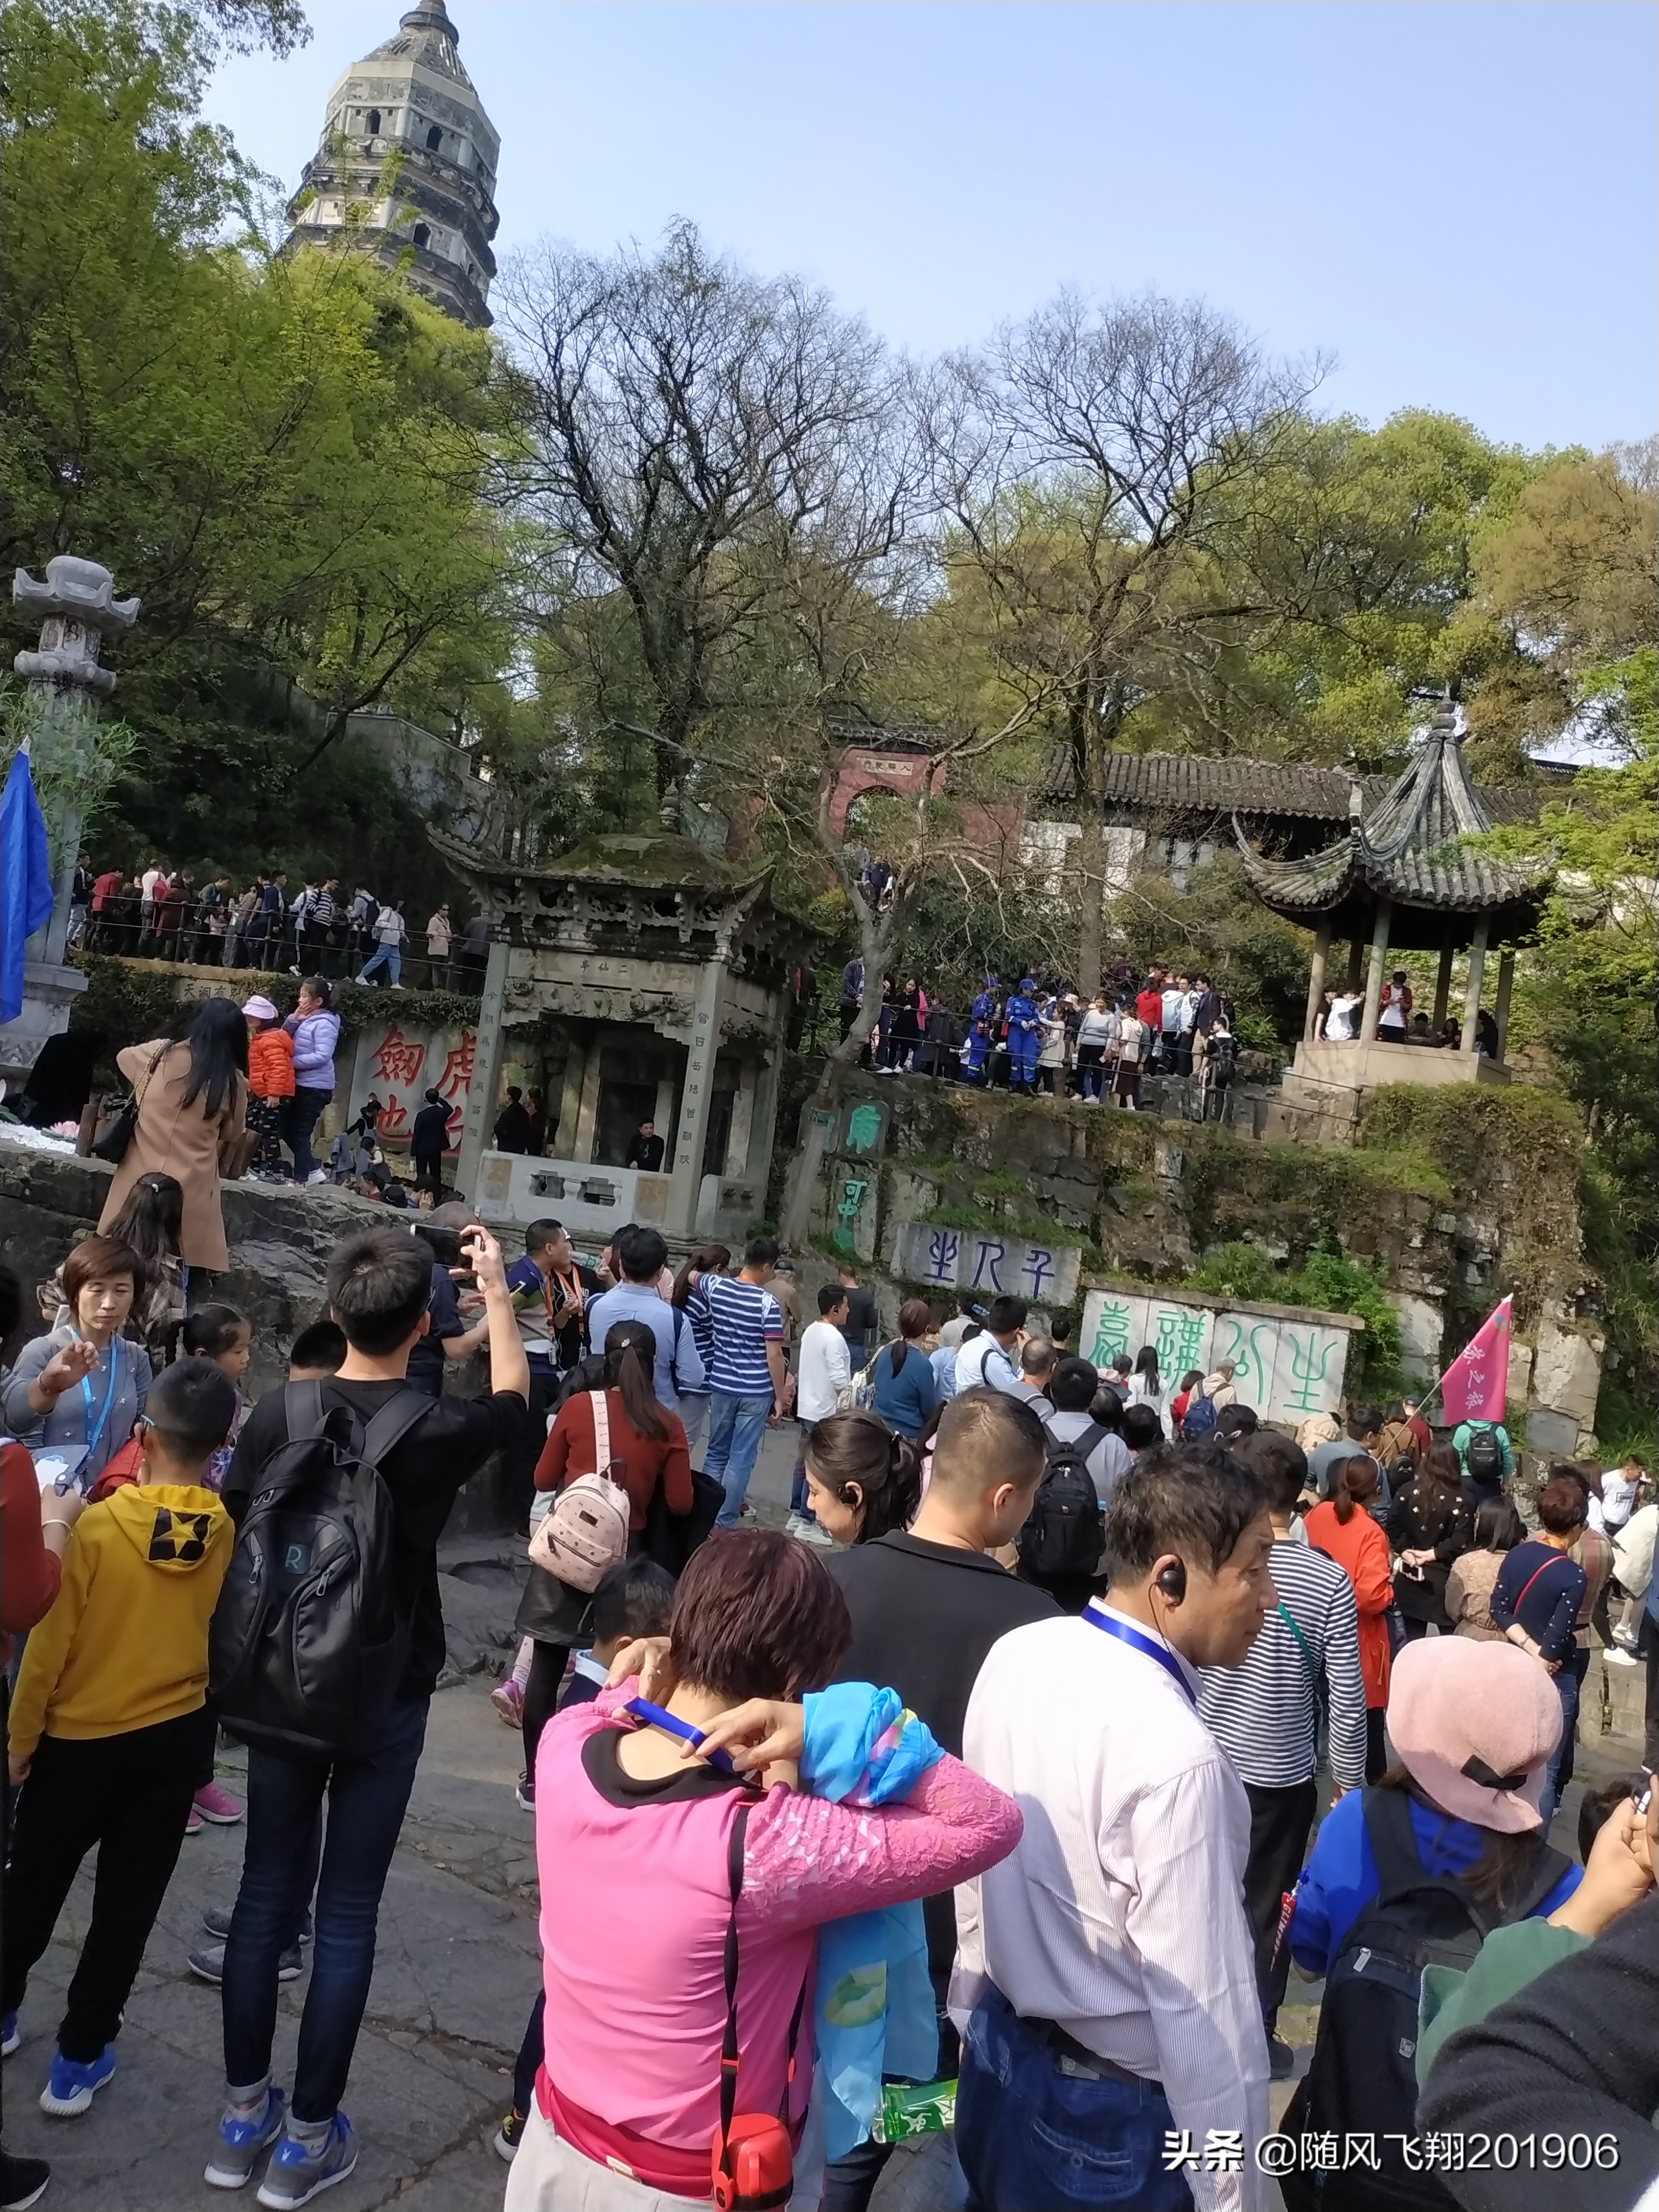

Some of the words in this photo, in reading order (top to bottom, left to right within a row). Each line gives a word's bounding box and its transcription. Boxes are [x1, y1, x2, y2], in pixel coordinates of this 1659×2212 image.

[581, 959, 628, 973] 二仙亭
[1463, 1344, 1485, 1410] 苏之旅
[285, 1545, 302, 1569] R
